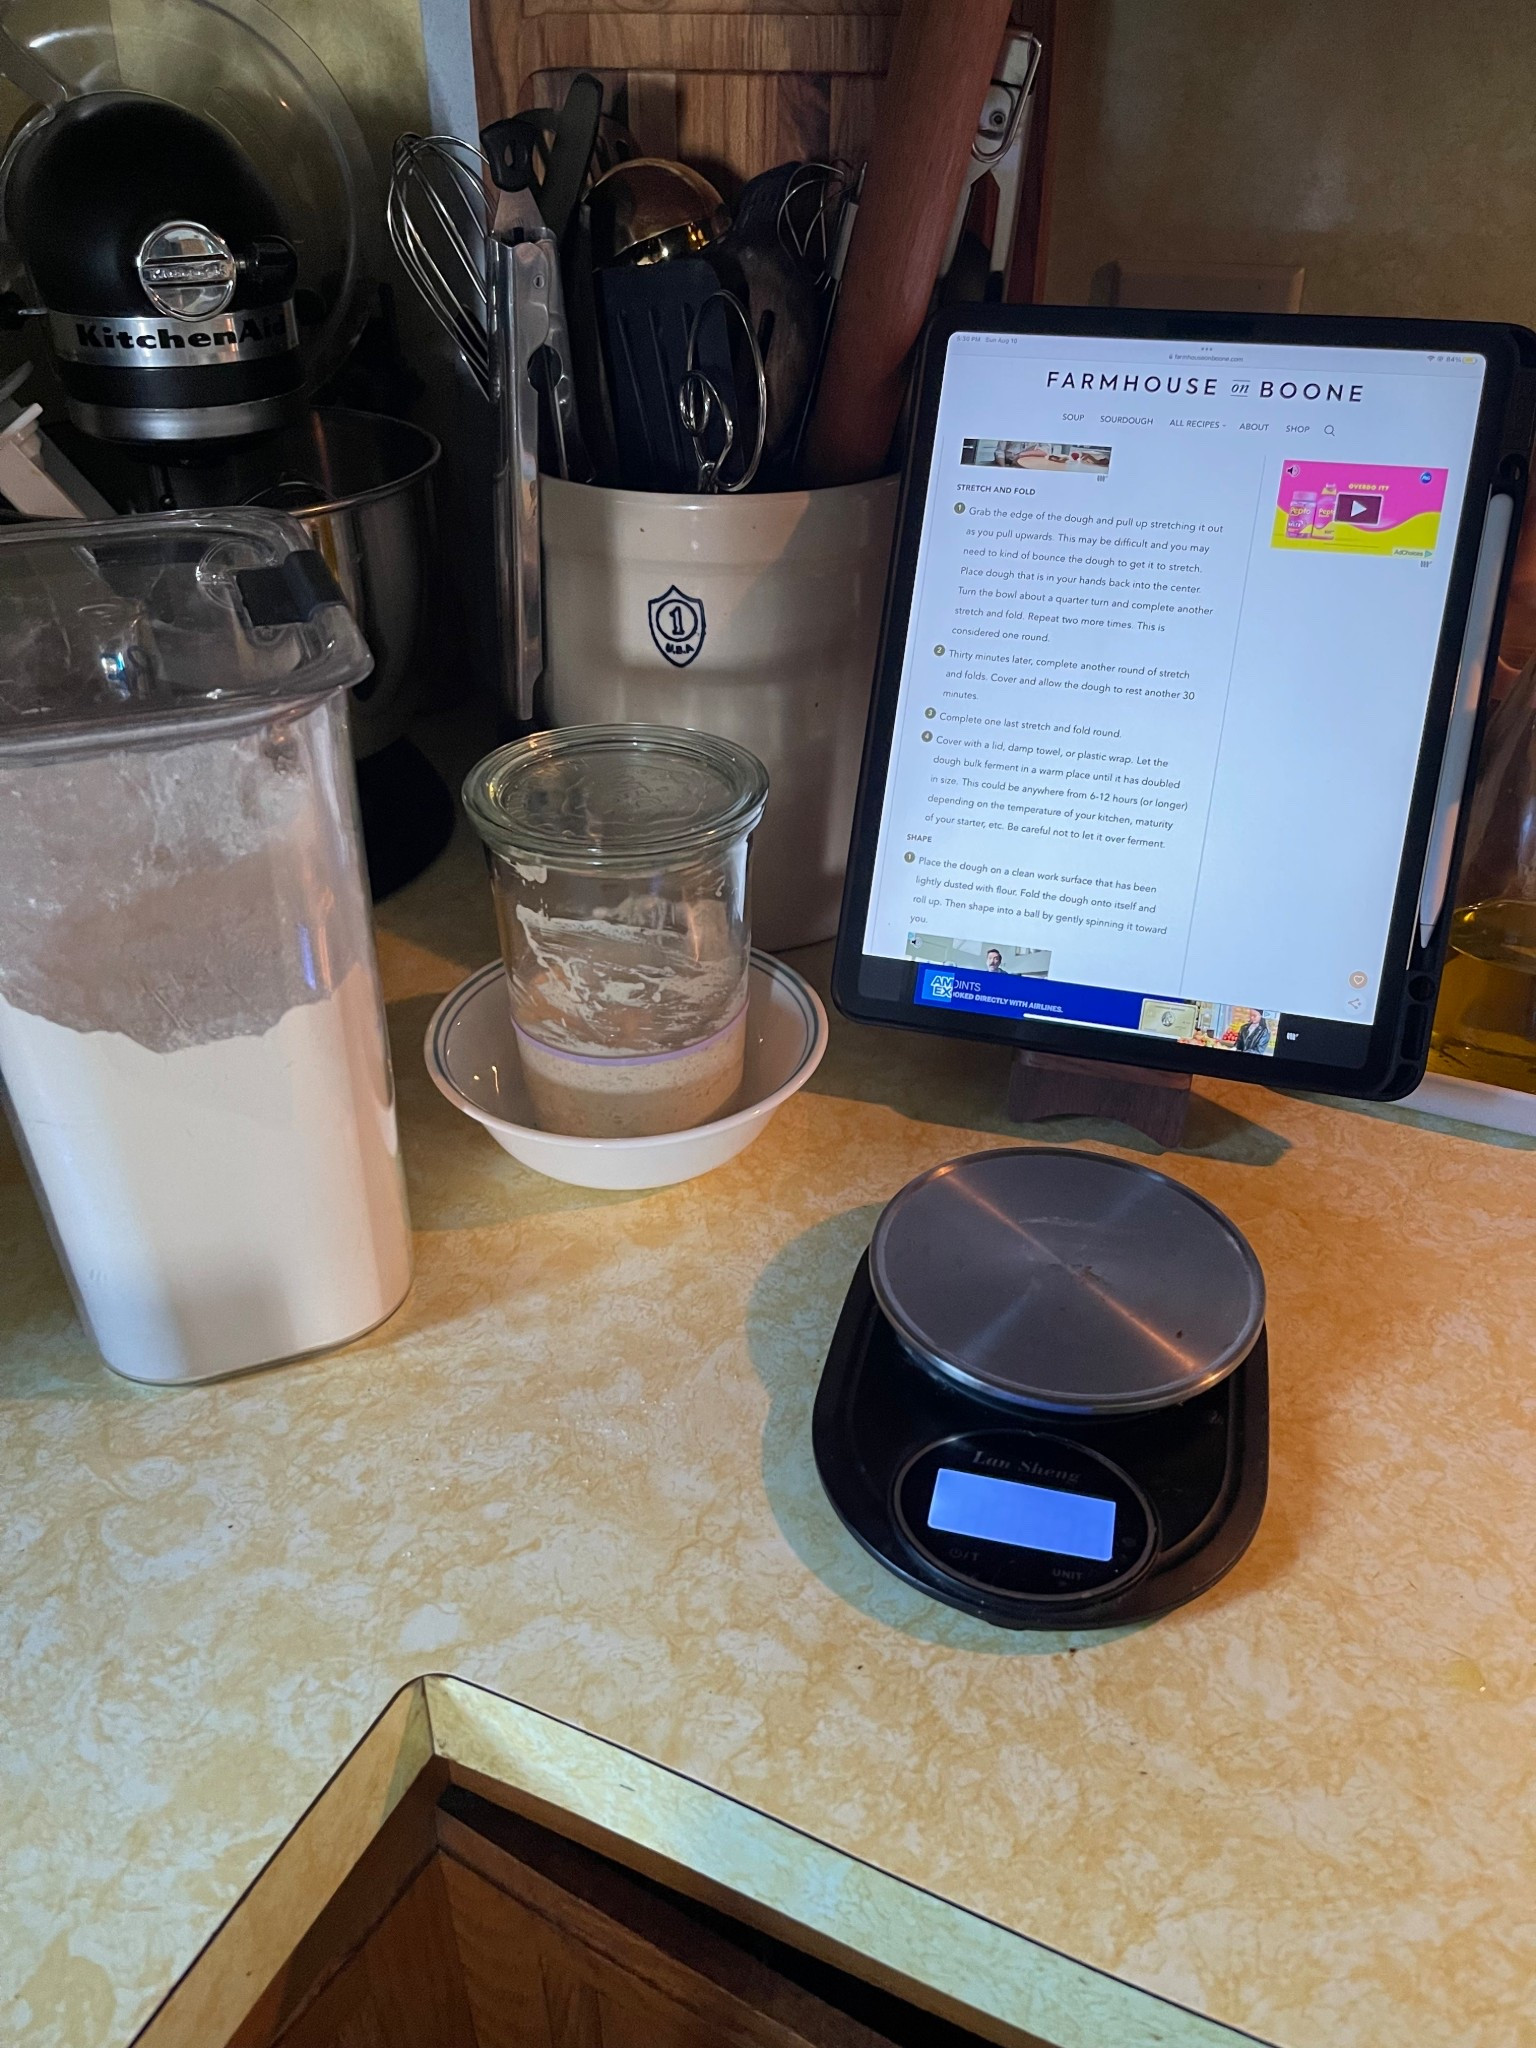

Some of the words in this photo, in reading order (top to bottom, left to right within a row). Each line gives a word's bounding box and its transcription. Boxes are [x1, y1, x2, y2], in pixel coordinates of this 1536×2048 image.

[75, 317, 286, 349] KitchenAid
[1047, 371, 1217, 395] FARMHOUSE
[1231, 382, 1250, 394] on
[1259, 381, 1363, 402] BOONE
[1062, 413, 1085, 421] SOUP
[1100, 415, 1154, 425] SOURDOUGH
[1169, 418, 1185, 428] ALL
[1186, 419, 1220, 429] RECIPES
[1238, 422, 1270, 431] ABOUT
[1285, 424, 1310, 433] SHOP
[956, 483, 992, 493] STRETCH
[993, 486, 1012, 494] AND
[1013, 487, 1036, 496] FOLD
[968, 506, 991, 516] Grab
[993, 508, 1008, 518] the
[1009, 510, 1034, 522] edge
[1047, 512, 1062, 522] the
[1064, 513, 1094, 526] dough
[1095, 516, 1114, 526] and
[1115, 517, 1134, 529] pull
[1150, 521, 1196, 534] stretching
[1207, 525, 1224, 533] out
[1290, 507, 1311, 517] Pepto
[963, 547, 986, 557] need
[999, 548, 1019, 559] kind
[1031, 551, 1066, 563] bounce
[1068, 554, 1083, 564] the
[1084, 555, 1115, 568] dough
[1129, 561, 1146, 571] get
[1394, 548, 1423, 557] AdChoices
[958, 586, 977, 596] Turn
[979, 588, 993, 597] the
[995, 588, 1018, 599] bowl
[1019, 591, 1046, 602] about
[1055, 596, 1089, 605] quarter
[1090, 598, 1109, 607] turn
[1111, 599, 1130, 609] and
[1131, 601, 1175, 613] complete
[1177, 605, 1213, 615] another
[669, 606, 685, 636] 1
[954, 607, 984, 616] stretch
[986, 609, 1004, 618] and
[1027, 611, 1060, 624] Repeat
[1061, 616, 1079, 625] two
[1080, 618, 1105, 627] more
[1137, 621, 1156, 631] This
[948, 649, 974, 662] Thirty
[974, 654, 1010, 663] minutes
[1035, 659, 1078, 670] complete
[1080, 662, 1116, 672] another
[1117, 666, 1146, 675] round
[1159, 669, 1190, 679] stretch
[939, 712, 982, 725] Complete
[984, 718, 1002, 726] one
[1003, 718, 1019, 728] last
[1021, 721, 1051, 731] stretch
[1053, 724, 1072, 733] and
[1072, 724, 1091, 735] fold
[935, 735, 962, 746] Cover
[963, 739, 982, 748] with
[1007, 742, 1034, 756] damp
[1076, 750, 1107, 761] plastic
[1136, 756, 1151, 766] Let
[1153, 757, 1169, 768] the
[962, 777, 979, 788] This
[981, 781, 1006, 791] could
[1021, 786, 1065, 797] anywhere
[1066, 788, 1087, 799] from
[1089, 791, 1111, 802] 6-12
[1112, 793, 1138, 805] hours
[1139, 796, 1154, 807] (or
[1154, 798, 1188, 812] longer)
[927, 794, 975, 809] depending
[990, 800, 1005, 810] the
[1007, 804, 1062, 817] temperature
[1074, 812, 1097, 821] your
[1135, 818, 1174, 832] maturity
[906, 833, 932, 843] SHAPE
[918, 856, 941, 867] Place
[943, 859, 958, 869] the
[959, 861, 988, 875] dough
[1011, 867, 1035, 878] clean
[1037, 872, 1059, 882] work
[1060, 874, 1093, 886] surface
[1095, 878, 1113, 888] that
[1115, 879, 1131, 891] has
[1133, 881, 1157, 893] been
[915, 875, 942, 889] lightly
[943, 879, 974, 891] dusted
[975, 884, 994, 893] with
[1020, 888, 1041, 899] Fold
[1042, 891, 1057, 901] the
[1058, 893, 1089, 907] dough
[1090, 899, 1112, 908] onto
[1114, 901, 1138, 911] itself
[1137, 904, 1157, 914] and
[931, 976, 954, 987] AM
[934, 986, 952, 998] EX
[974, 994, 1009, 1006] DIRECTLY
[1009, 999, 1028, 1008] WITH
[1028, 1002, 1064, 1013] AIRLINES.
[1017, 1460, 1082, 1484] Sheng
[1052, 1567, 1083, 1580] UNIT
